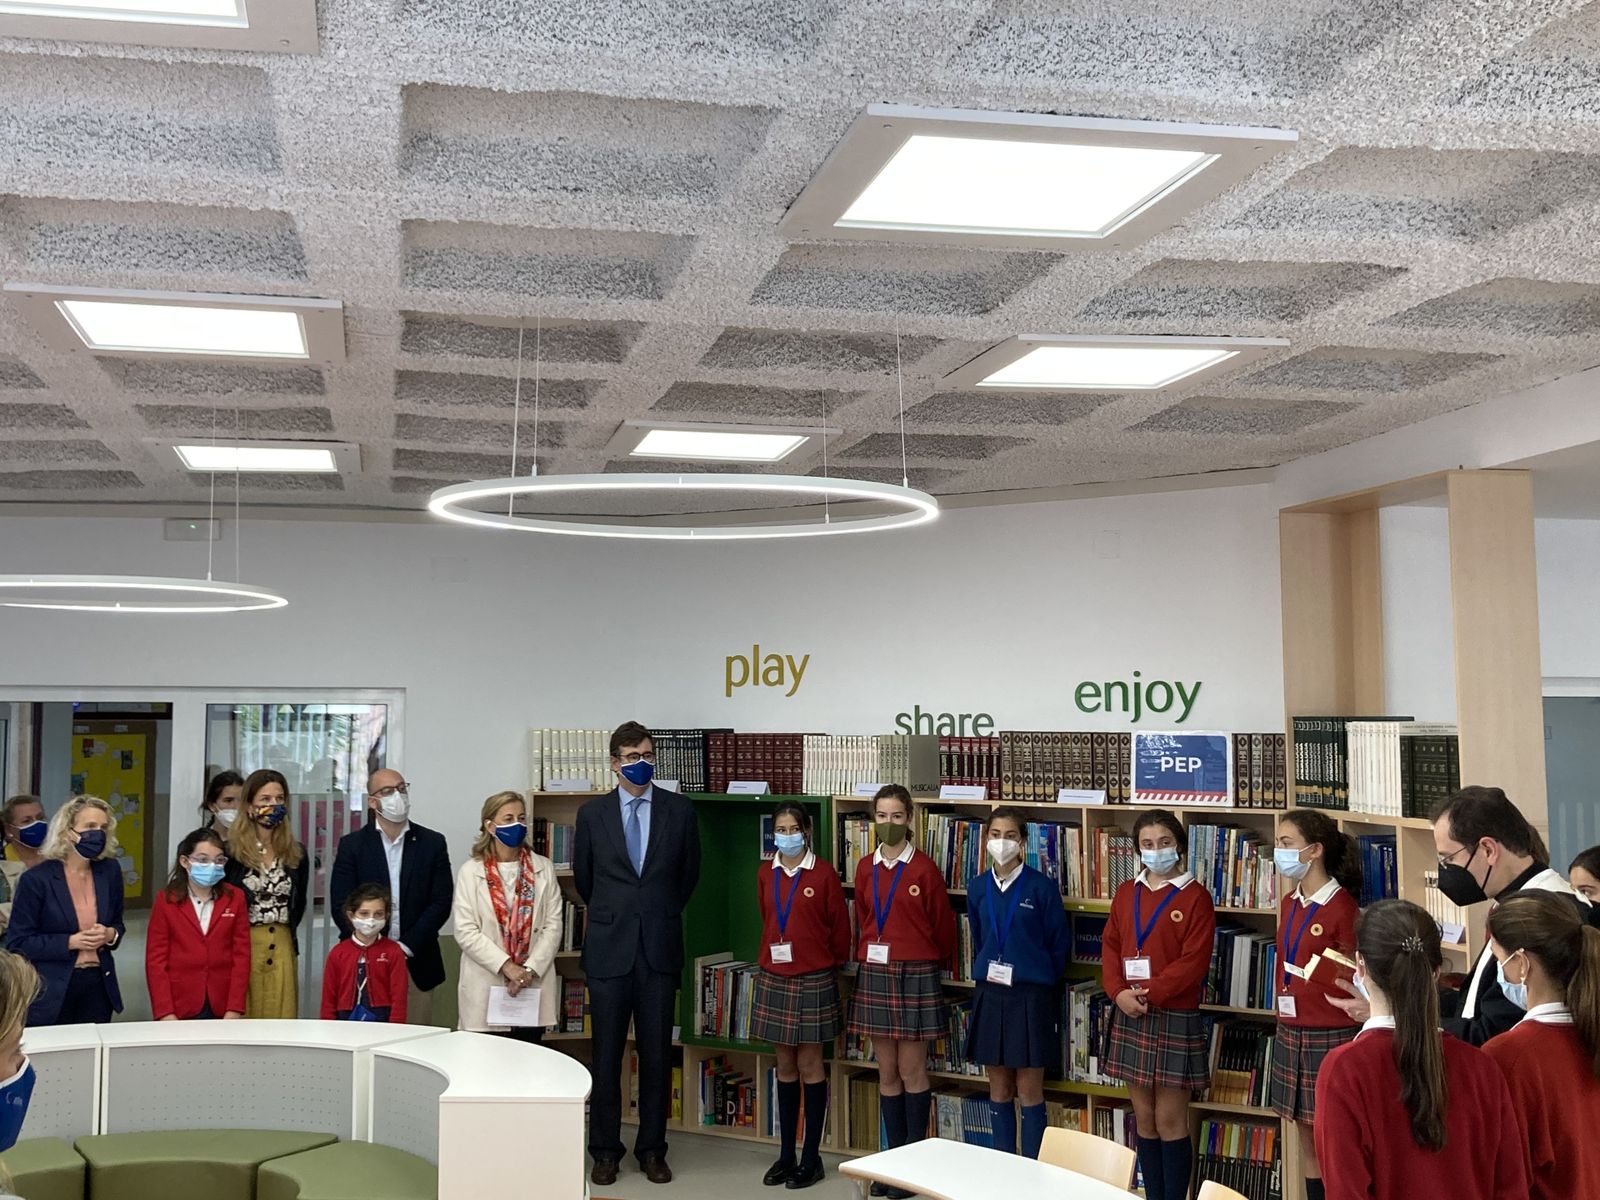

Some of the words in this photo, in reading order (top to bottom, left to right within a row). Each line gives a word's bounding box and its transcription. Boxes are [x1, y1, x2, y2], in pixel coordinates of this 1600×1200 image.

[725, 644, 810, 698] play
[1074, 670, 1202, 723] enjoy
[894, 705, 995, 737] share
[1160, 756, 1202, 773] PEP
